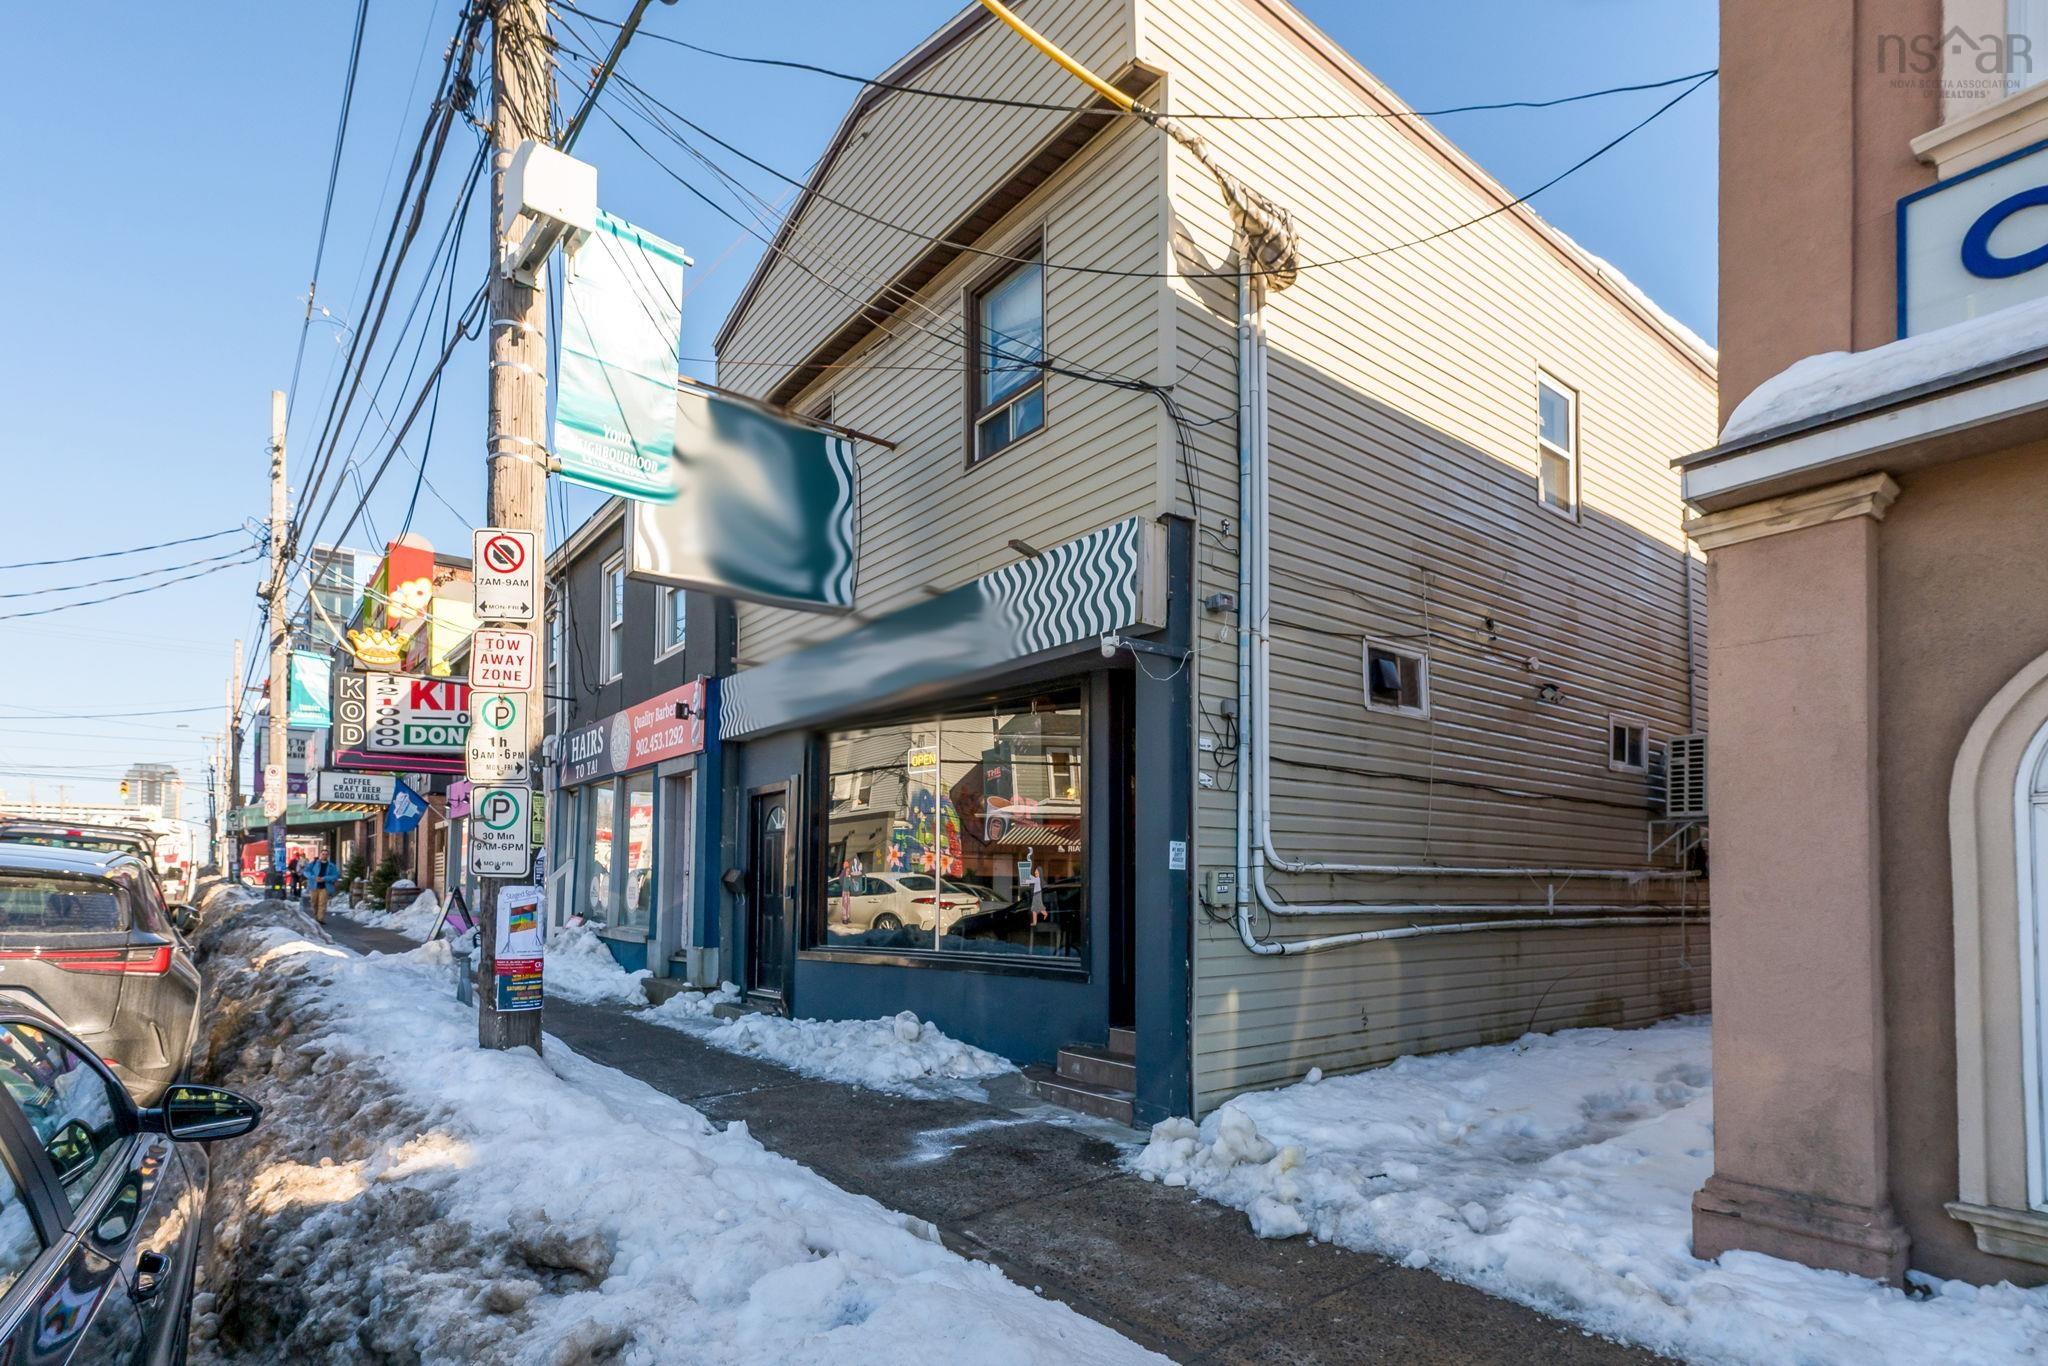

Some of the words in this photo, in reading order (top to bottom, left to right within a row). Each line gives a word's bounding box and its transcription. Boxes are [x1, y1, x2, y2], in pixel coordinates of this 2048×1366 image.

[479, 578, 529, 587] 7AM-9AM
[485, 638, 520, 650] TOW
[480, 653, 524, 666] AWAY
[482, 668, 521, 681] ZONE
[410, 680, 471, 711] KI
[633, 707, 655, 734] Quality
[571, 725, 604, 763] HAIRS
[635, 724, 684, 757] 902.453.1292
[911, 752, 937, 768] OPEN
[576, 762, 585, 778] TO
[343, 777, 371, 785] COFFEE
[333, 784, 359, 792] CRAFT
[362, 786, 381, 794] BEER
[334, 792, 355, 800] GOOD
[357, 793, 380, 801] VIBES
[482, 832, 494, 840] 30
[497, 832, 515, 840] Min
[476, 842, 524, 851] 9AM-6PM
